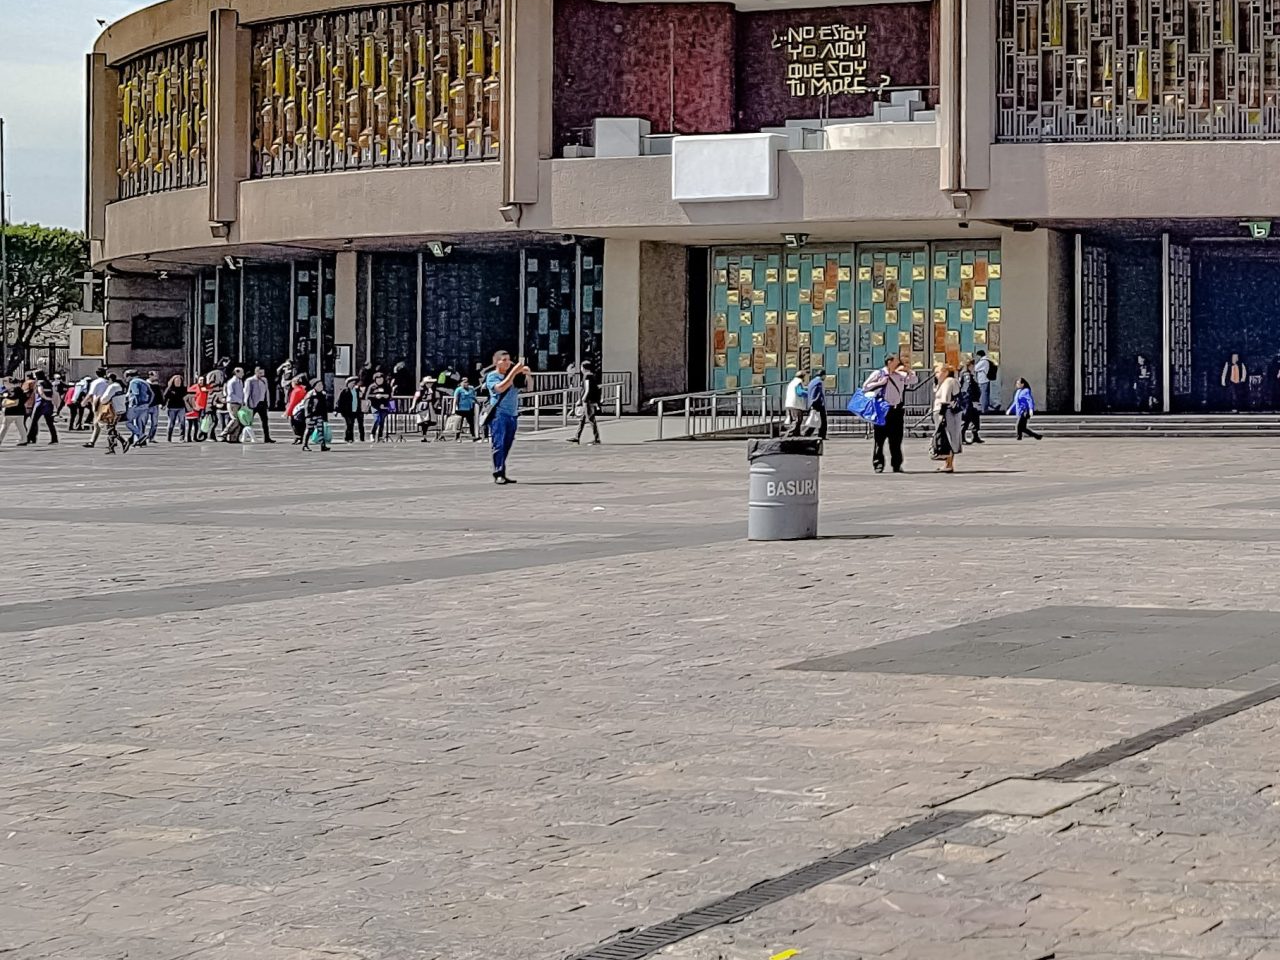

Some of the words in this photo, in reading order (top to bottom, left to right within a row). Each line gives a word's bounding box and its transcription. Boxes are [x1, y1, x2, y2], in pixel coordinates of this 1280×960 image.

[788, 43, 816, 60] YO
[820, 41, 866, 59] AQUI
[788, 62, 825, 79] QUE
[826, 60, 867, 77] SOY
[786, 79, 805, 96] TU
[785, 234, 798, 247] 5
[766, 479, 818, 497] BASURA
